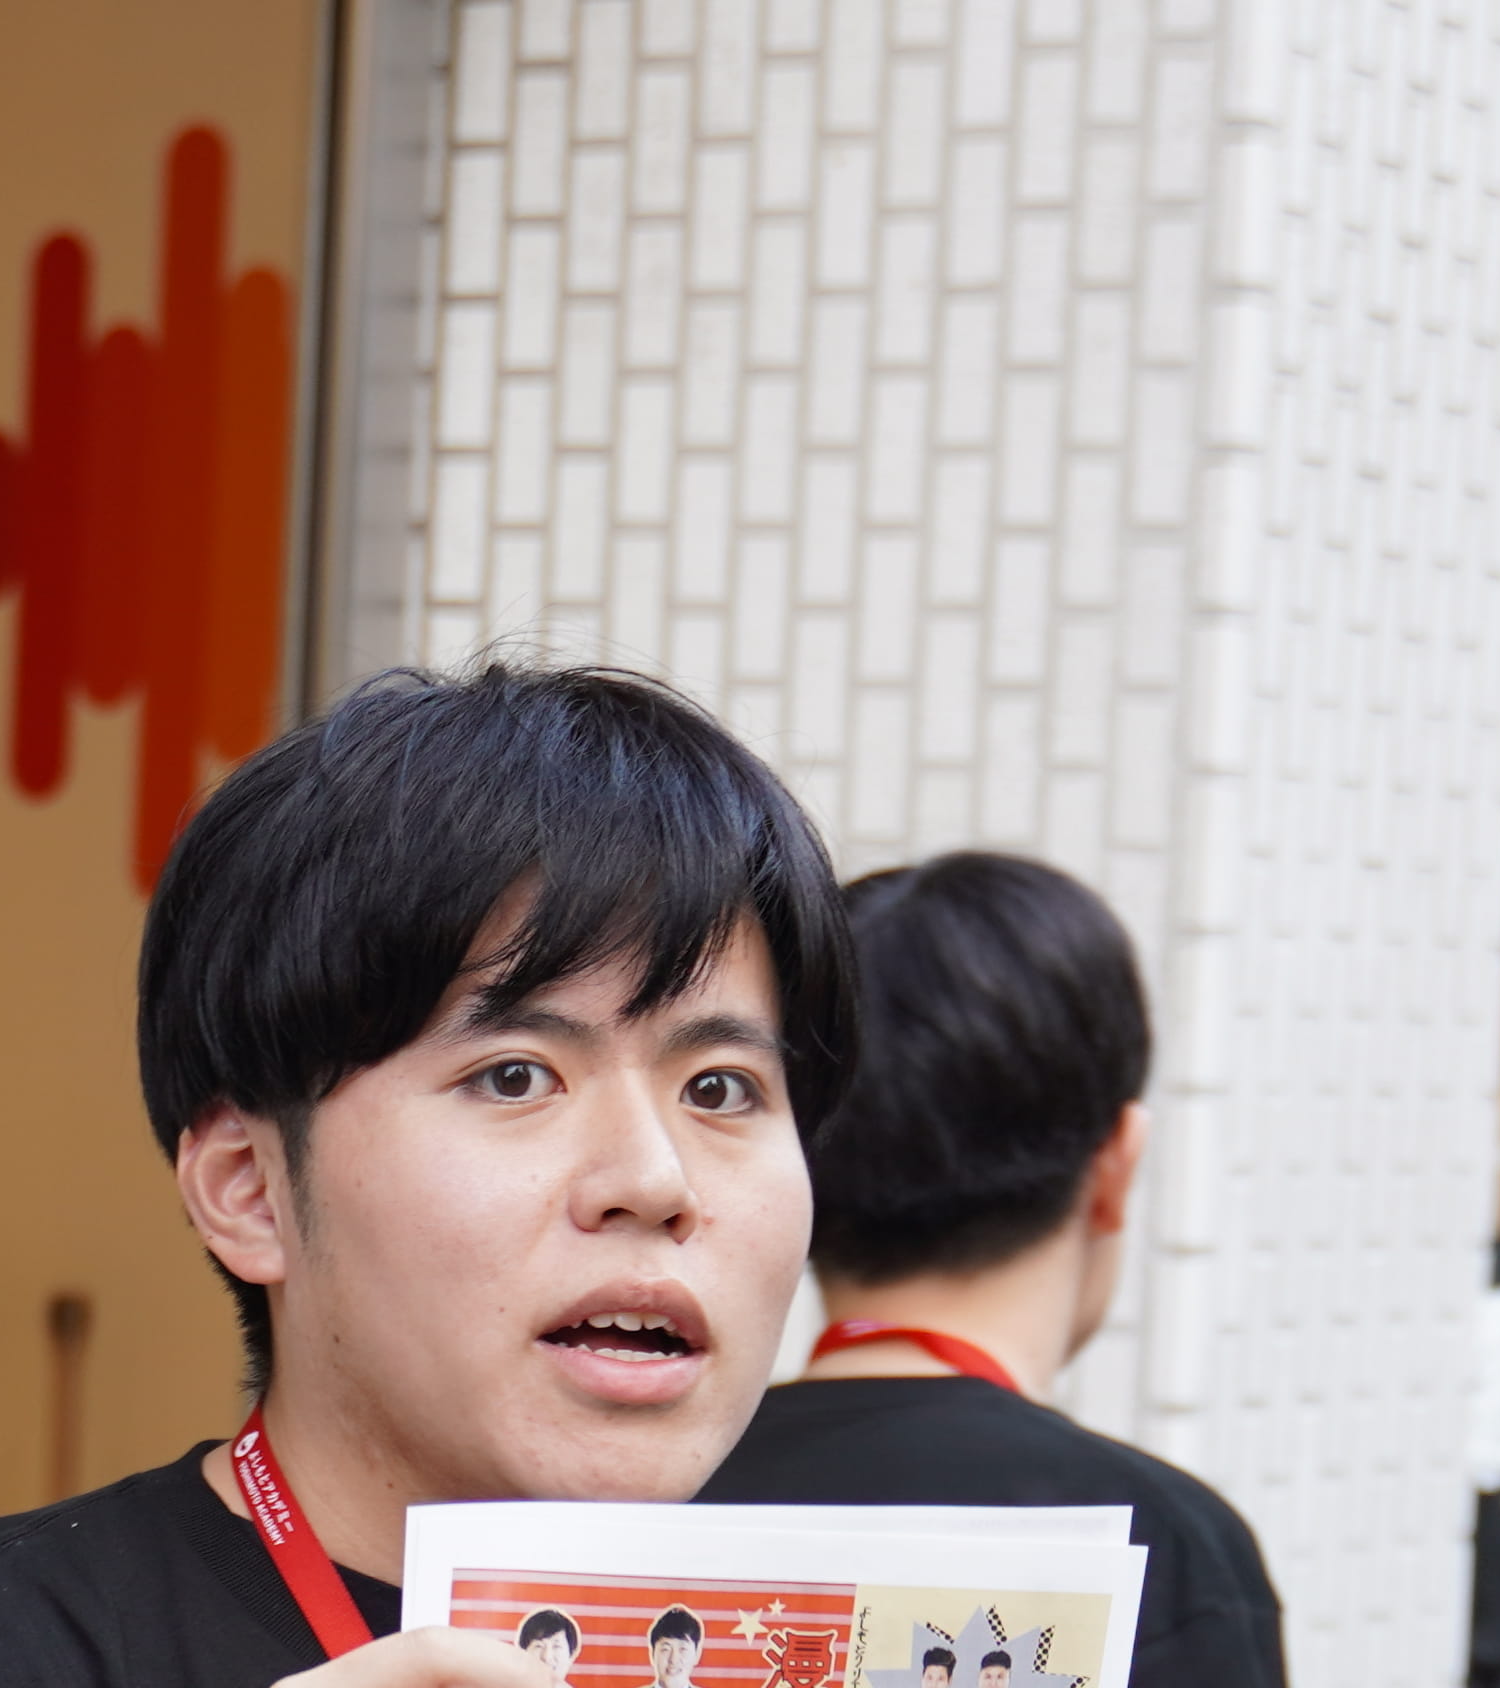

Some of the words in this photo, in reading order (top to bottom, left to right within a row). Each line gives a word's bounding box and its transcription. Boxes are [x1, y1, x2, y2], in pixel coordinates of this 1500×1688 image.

[248, 1450, 294, 1533] よしもとアカデミー
